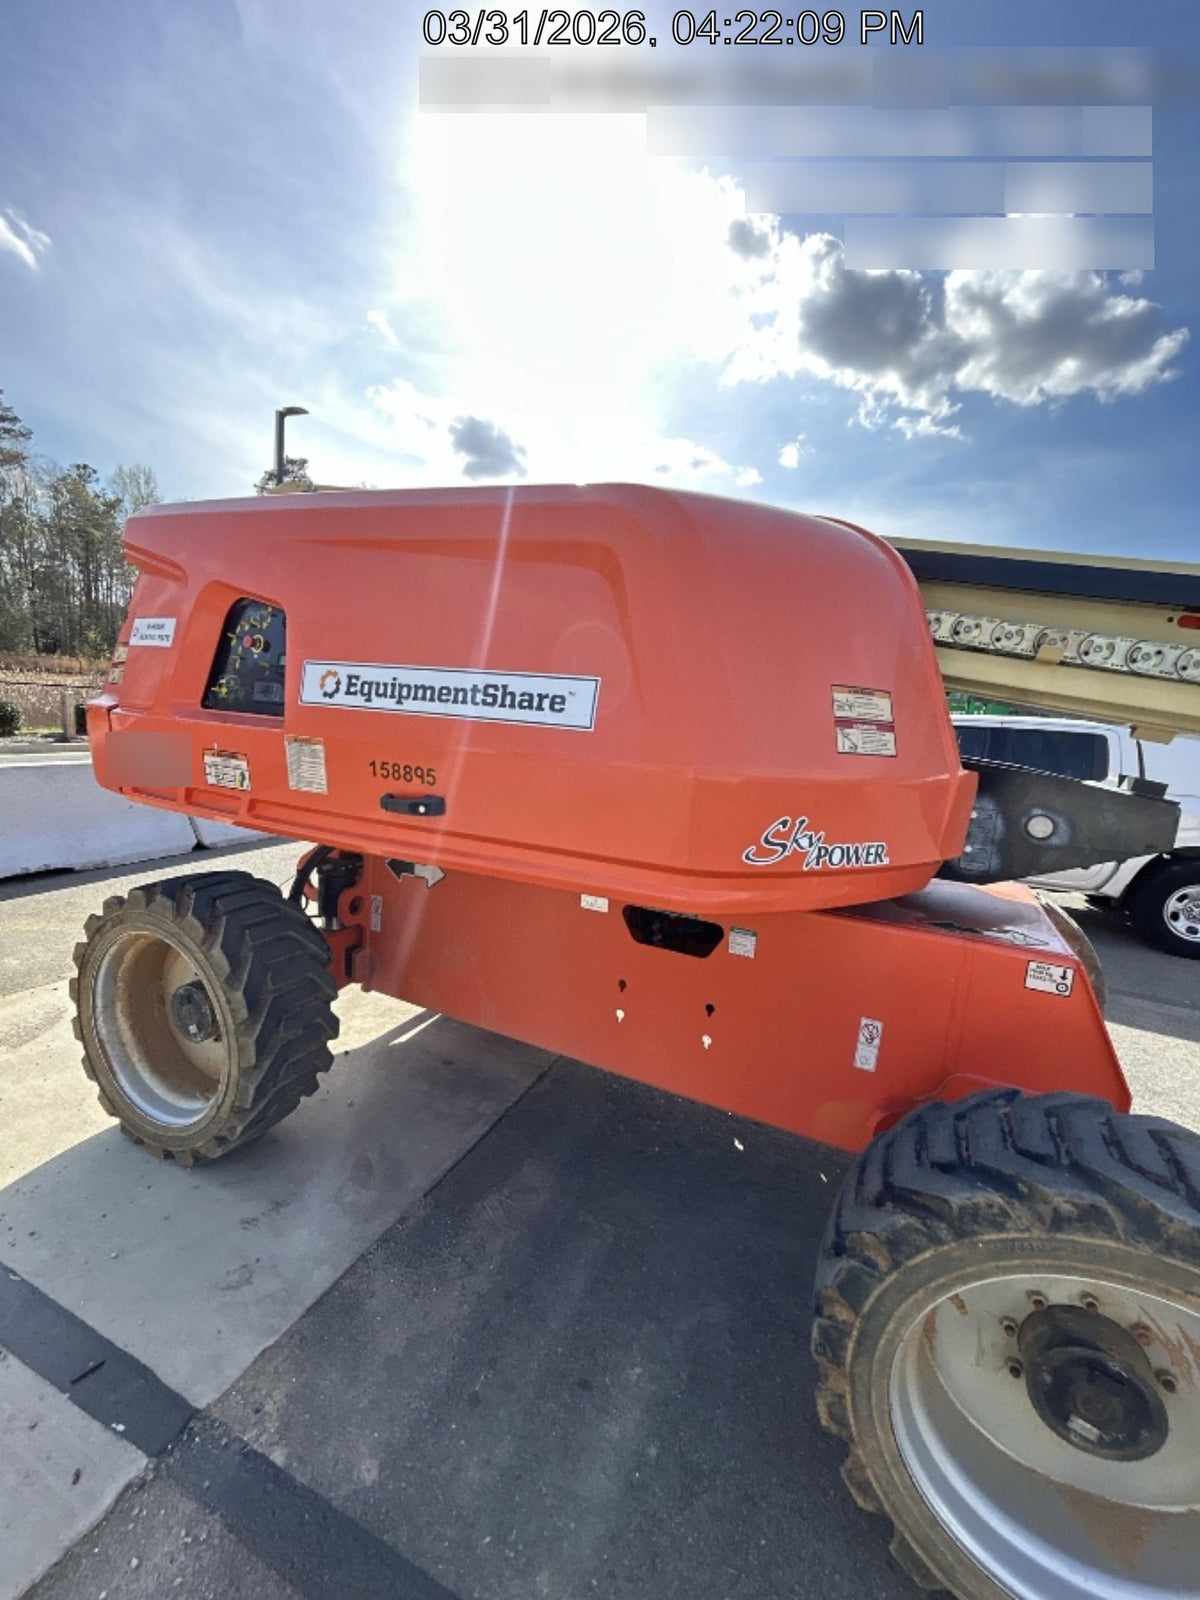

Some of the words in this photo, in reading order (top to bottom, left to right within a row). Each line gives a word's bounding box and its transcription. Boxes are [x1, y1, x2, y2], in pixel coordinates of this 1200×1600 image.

[345, 675, 567, 714] EquipmentShare
[369, 759, 437, 787] 158895
[744, 817, 823, 869] Sky
[814, 844, 886, 867] POWER
